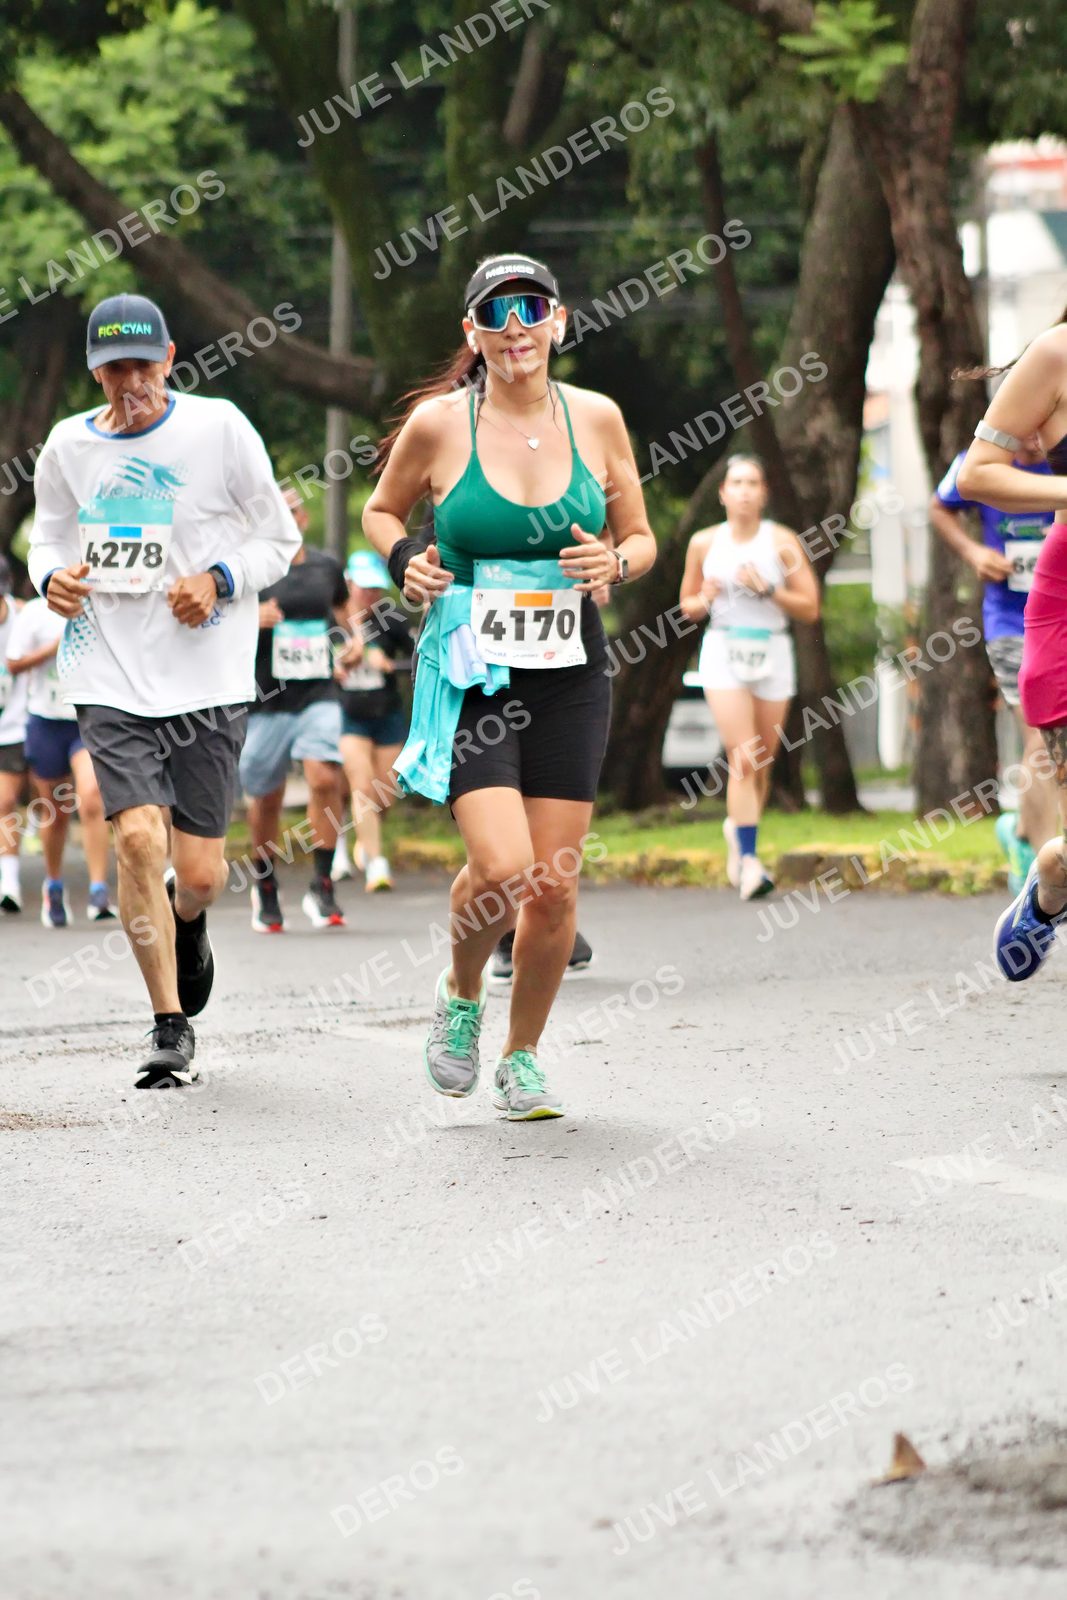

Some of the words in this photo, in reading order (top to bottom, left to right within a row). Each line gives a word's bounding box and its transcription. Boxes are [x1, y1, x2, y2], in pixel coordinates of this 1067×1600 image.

[98, 322, 152, 338] FICOCYAN
[86, 541, 163, 568] 4278
[480, 609, 575, 641] 4170
